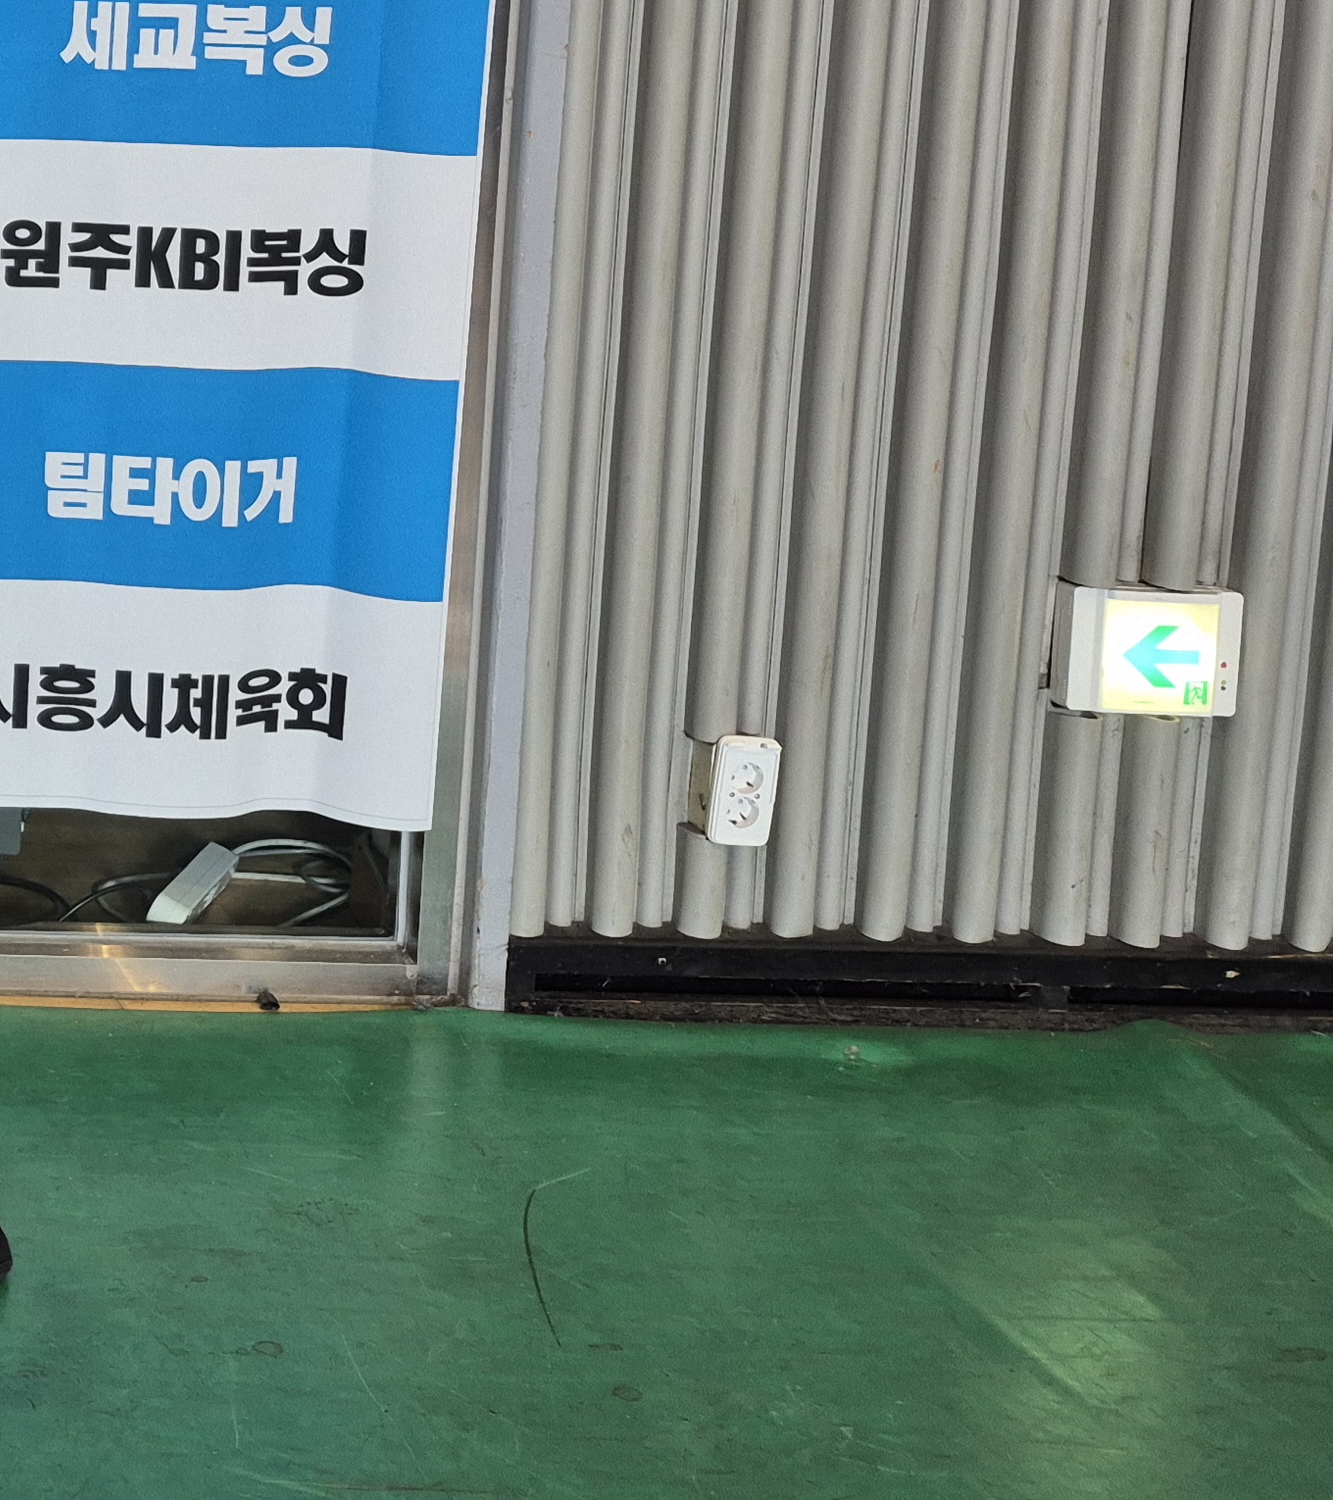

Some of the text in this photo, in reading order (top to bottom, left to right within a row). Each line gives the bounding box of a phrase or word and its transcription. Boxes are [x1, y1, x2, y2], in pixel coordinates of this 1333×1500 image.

[59, 0, 333, 78] 세교복싱
[0, 219, 367, 296] 원주KBI복싱
[44, 450, 298, 528] 팀타이거
